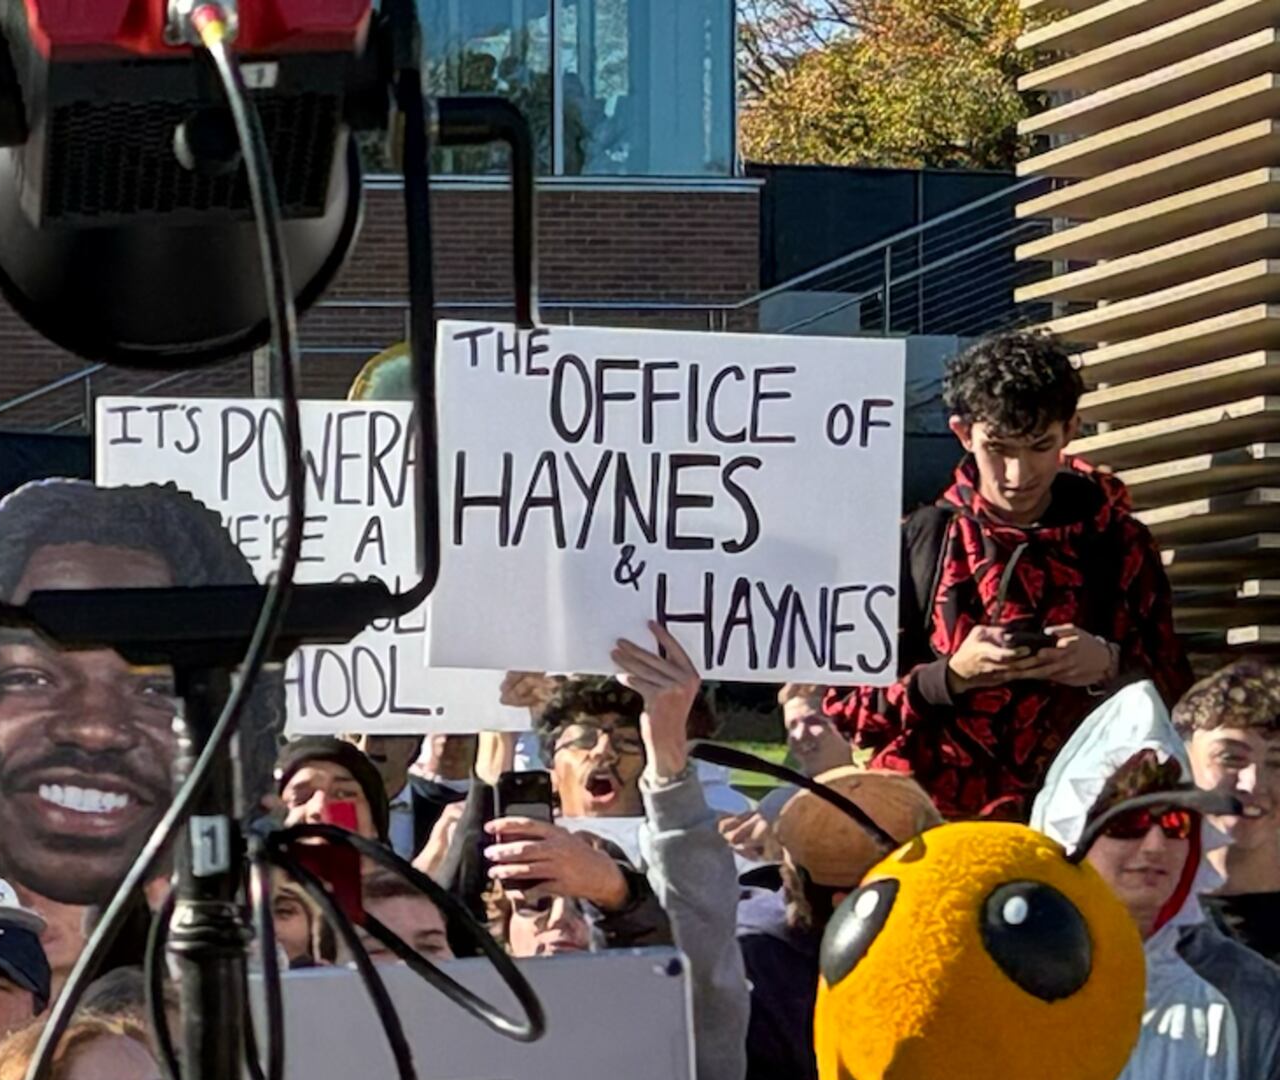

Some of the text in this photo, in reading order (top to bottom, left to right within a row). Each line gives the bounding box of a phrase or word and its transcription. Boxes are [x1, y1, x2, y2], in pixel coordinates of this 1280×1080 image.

[106, 403, 203, 454] IT'S
[452, 327, 894, 448] THE OFFICE OF
[353, 515, 387, 566] A
[452, 451, 764, 554] HAYNES
[614, 545, 897, 674] & HAYNES
